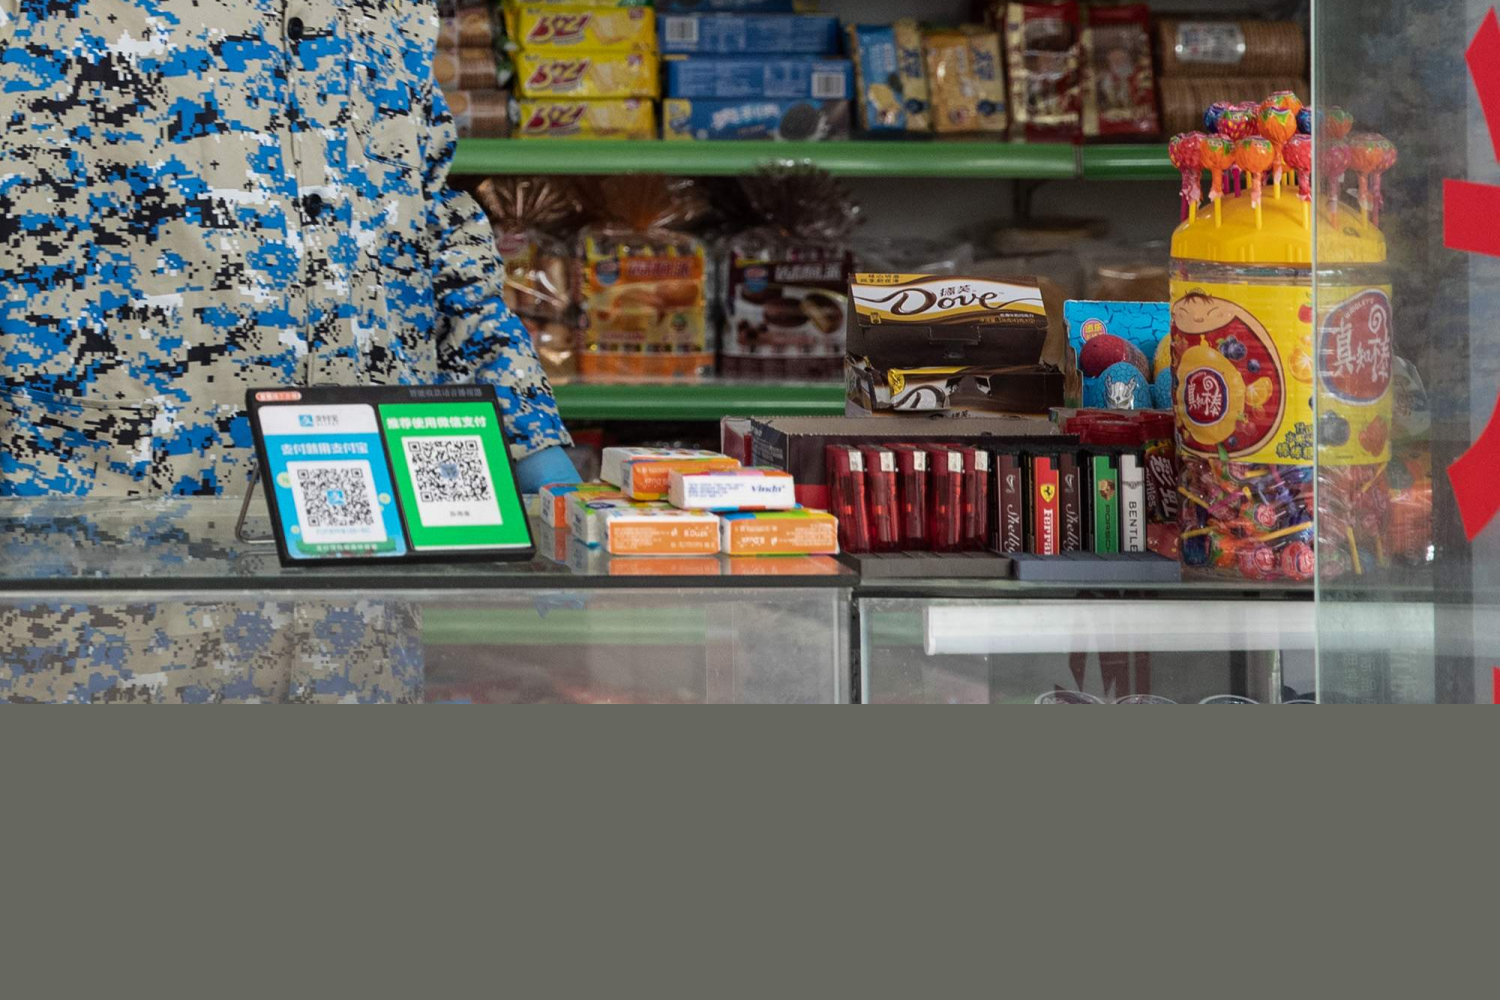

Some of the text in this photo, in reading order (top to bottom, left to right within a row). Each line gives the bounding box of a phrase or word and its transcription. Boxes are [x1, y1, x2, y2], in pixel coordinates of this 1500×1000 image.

[890, 287, 999, 316] Dove
[1333, 303, 1390, 382] 真知棒
[386, 415, 487, 430] 推荐使用微信支付
[1003, 503, 1021, 554] Shelby
[1128, 501, 1138, 552] BENTLE
